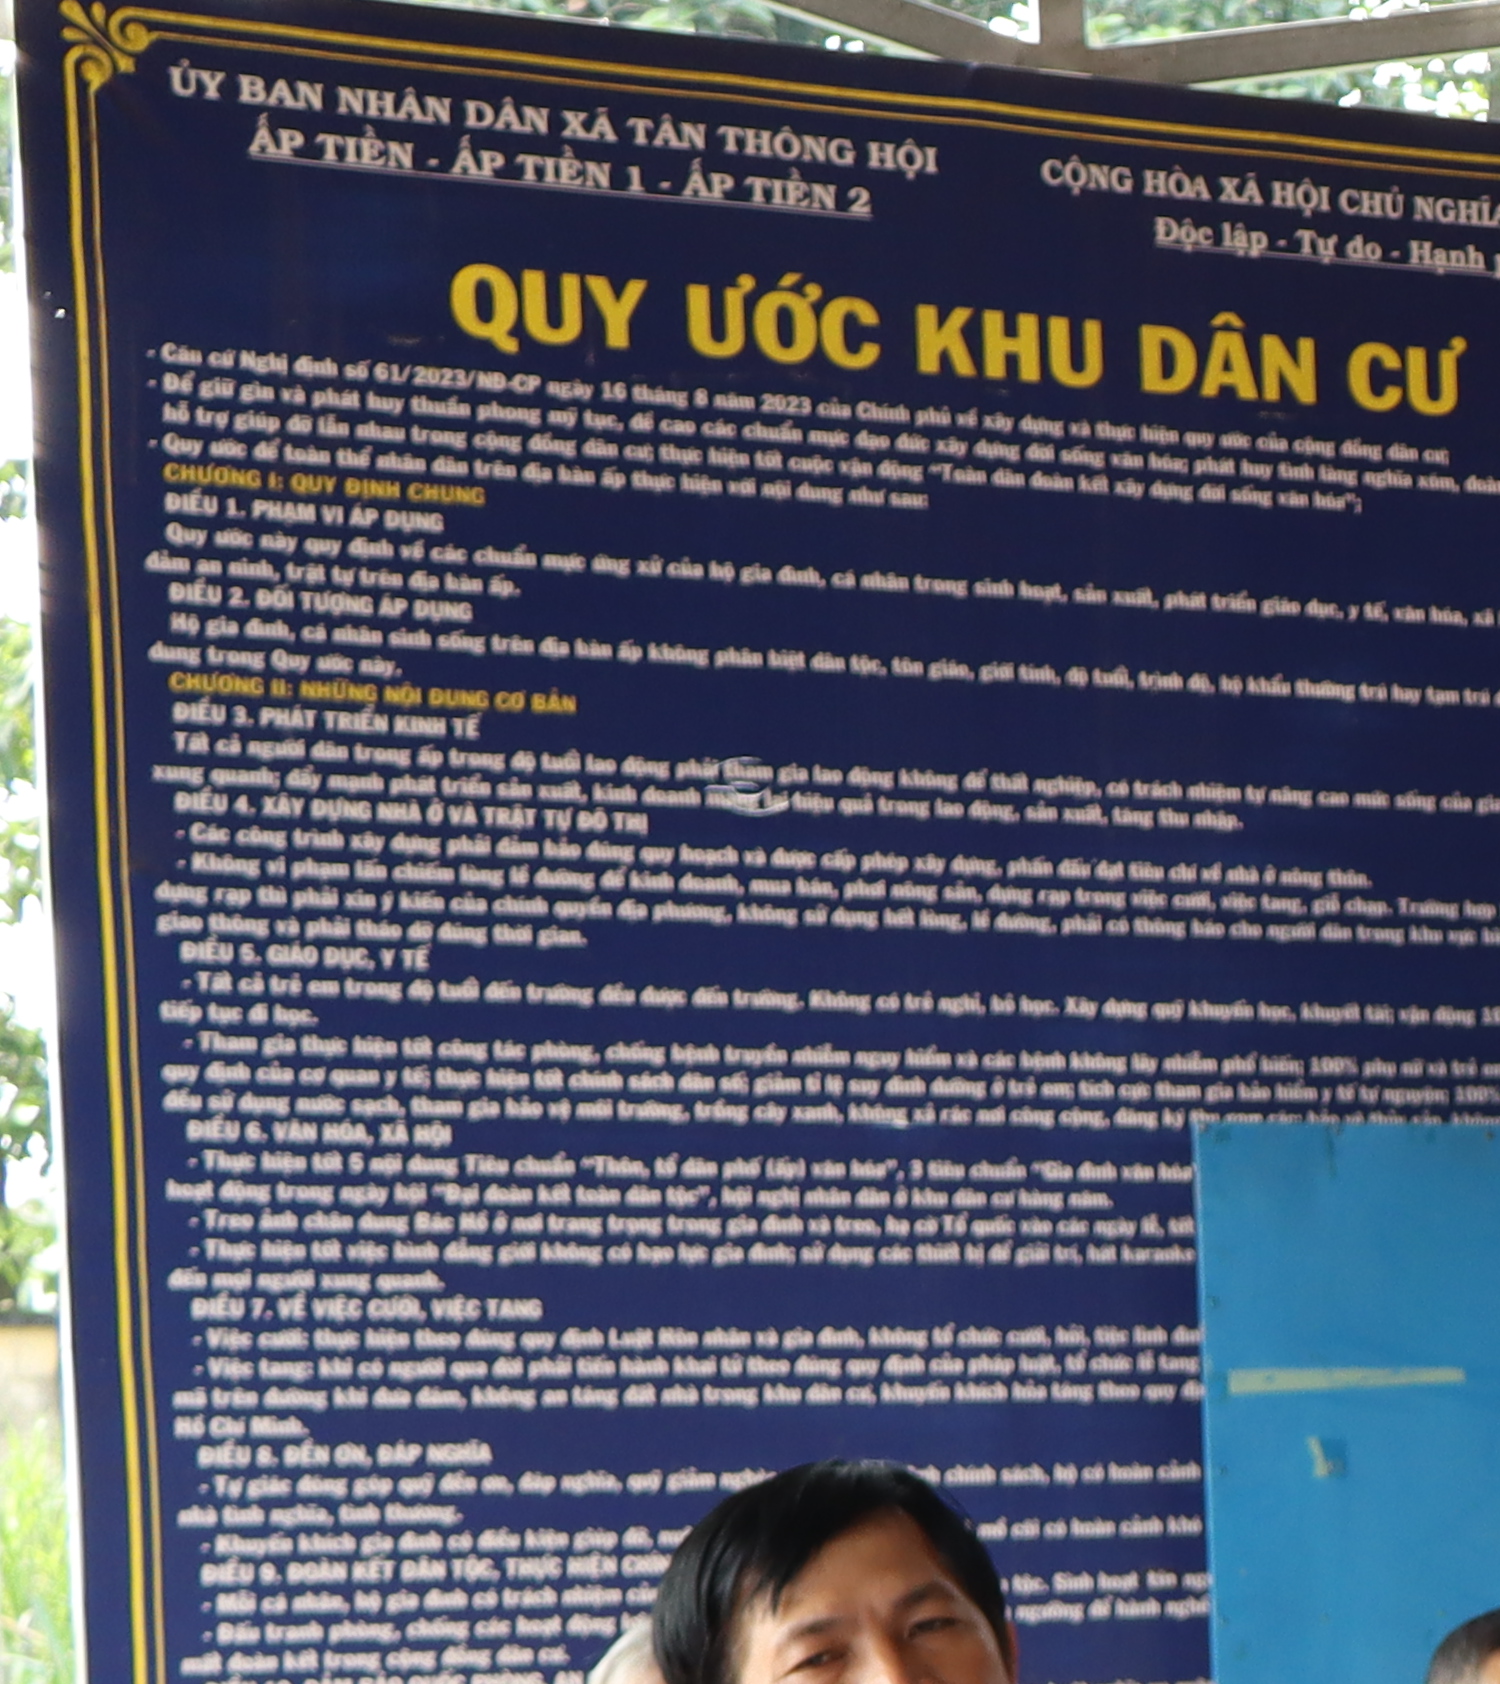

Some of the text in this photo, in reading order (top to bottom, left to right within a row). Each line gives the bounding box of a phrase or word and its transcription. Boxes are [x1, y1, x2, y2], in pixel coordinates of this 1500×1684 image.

[169, 61, 938, 179] ỦY BAN NHÂN DÂN XÃ TÂN THÔNG HỘI
[248, 113, 309, 157] ẤP
[316, 127, 415, 169] TIỀN
[449, 134, 505, 179] ẤP
[515, 145, 611, 190] TIỀN
[628, 166, 644, 193] 1
[682, 157, 735, 200] ẤP
[744, 167, 837, 212] TIỀN
[847, 186, 871, 214] 2
[1040, 154, 1134, 196] CỘNG
[1143, 165, 1212, 202] HÒA
[1218, 172, 1264, 206] XÃ
[1271, 178, 1331, 218] HỘI
[1338, 186, 1404, 220] CHỦ
[1154, 217, 1216, 250] Độc
[1222, 221, 1269, 255] lập
[1297, 229, 1338, 260] Tự
[1345, 234, 1383, 263] do
[1409, 239, 1486, 271] Hạnh
[449, 263, 1468, 416] QUY ƯỚC KHU DÂN CƯ
[162, 462, 263, 489] CHƯƠNG
[289, 472, 338, 495] QUY
[343, 476, 402, 499] ĐỊNH
[406, 482, 486, 506] CHUNG
